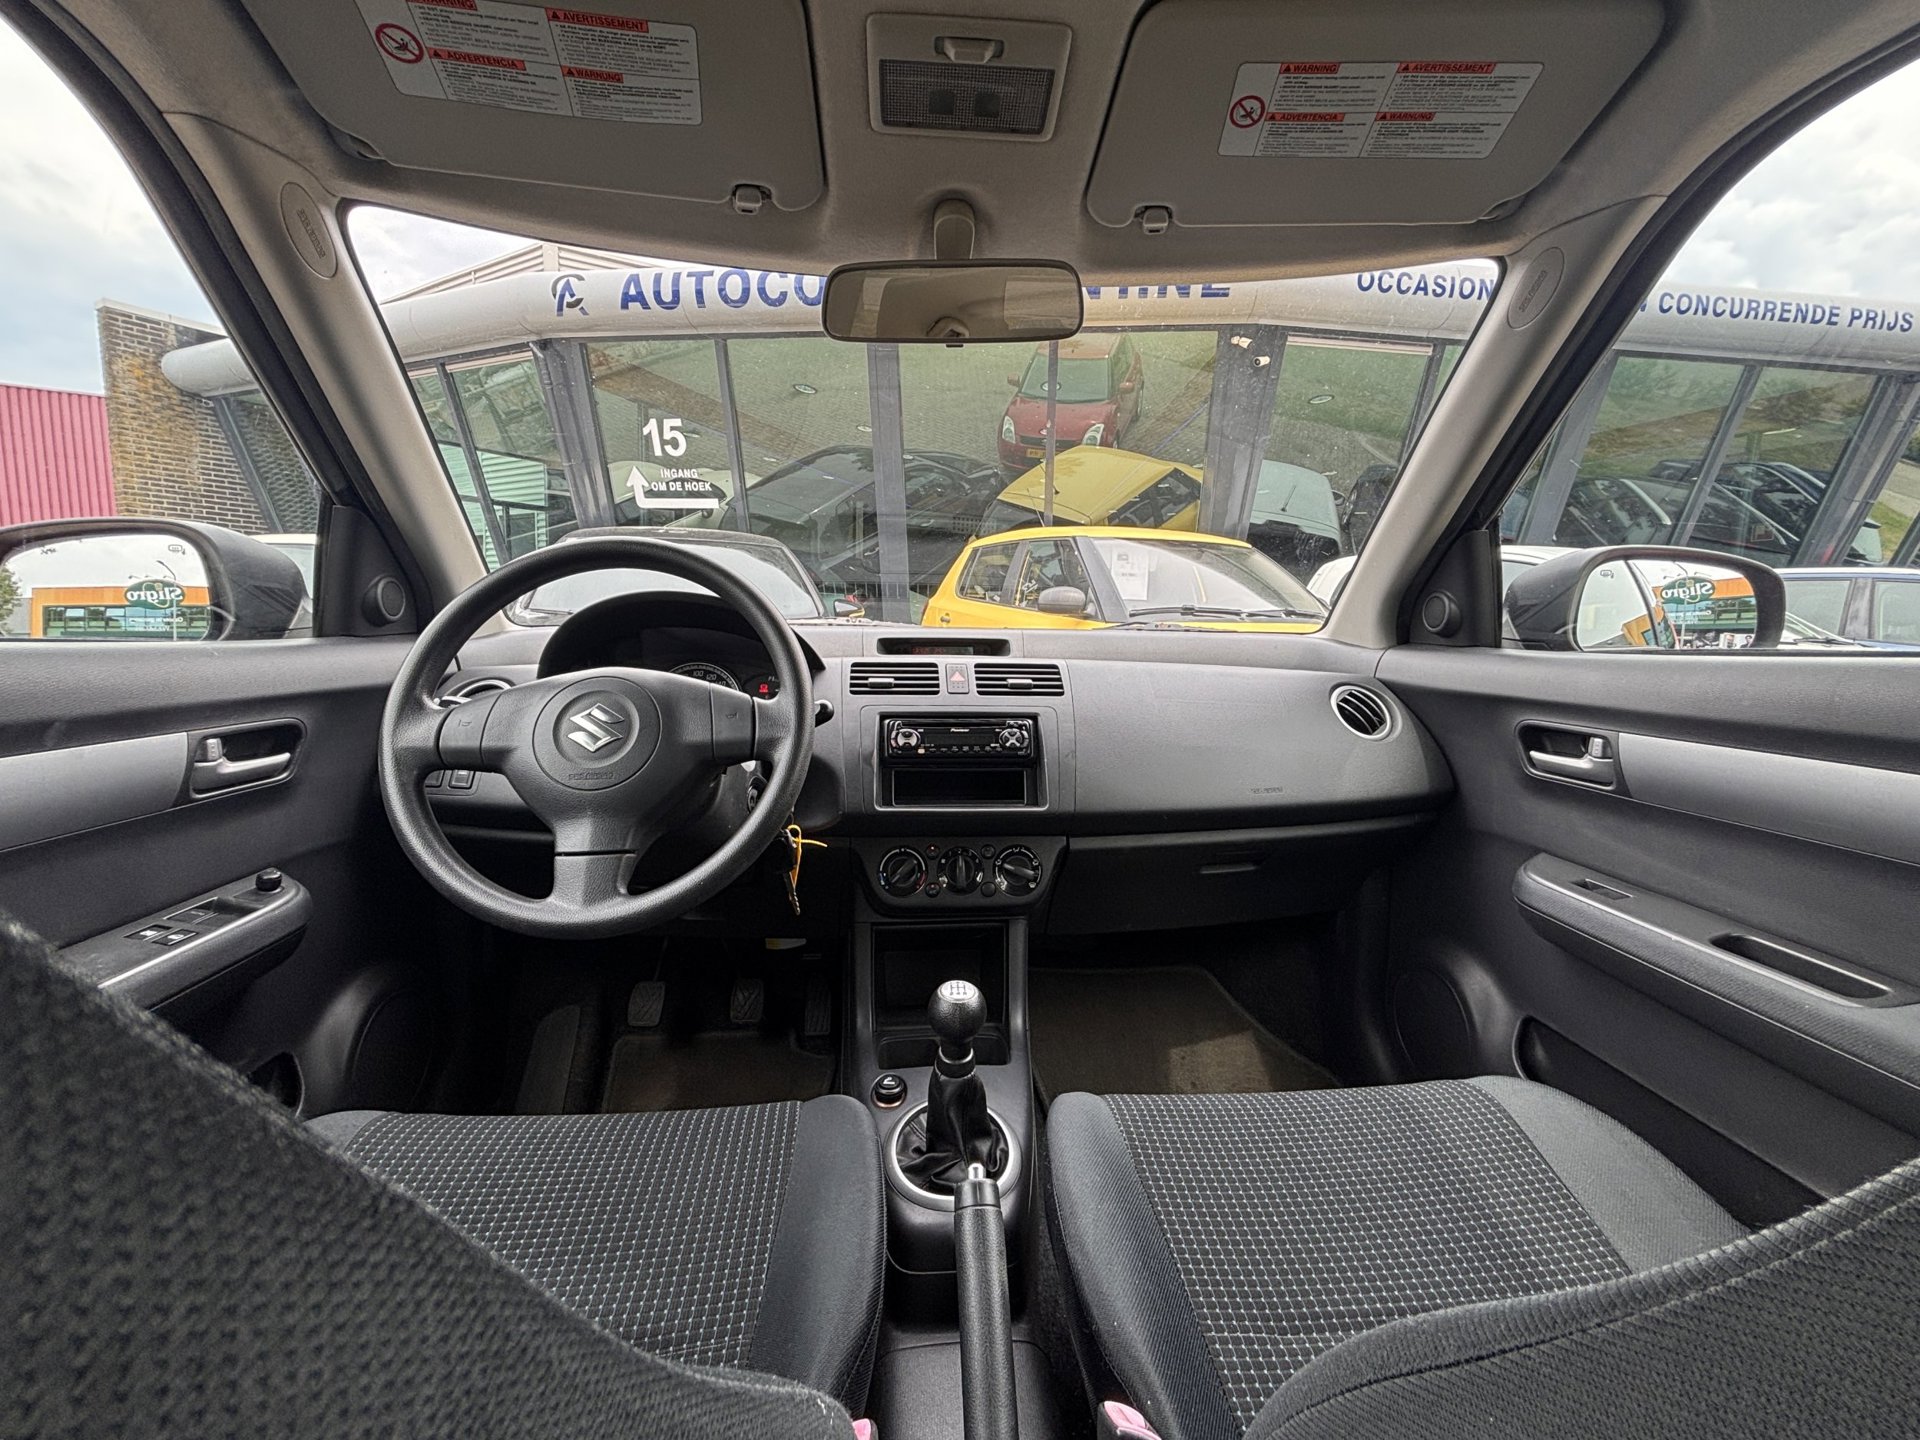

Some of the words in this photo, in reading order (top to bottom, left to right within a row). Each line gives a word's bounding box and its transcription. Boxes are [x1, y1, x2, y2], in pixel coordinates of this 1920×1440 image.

[563, 12, 644, 31] AVERTISSEMENT
[446, 51, 518, 68] ADVERTENCIA
[1293, 64, 1337, 73] WARNING
[1412, 63, 1491, 73] AVERTISSEMENT
[575, 68, 621, 82] WARNUNG
[1280, 113, 1338, 121] ADVERTENCIA
[1389, 112, 1432, 121] WARNUNG
[1658, 292, 1840, 327] CONCURRENDE
[1847, 307, 1914, 333] PRIJS
[642, 418, 687, 457] 15
[660, 468, 698, 478] INGANG
[651, 481, 667, 491] OM
[669, 482, 683, 491] DE
[685, 482, 712, 491] HOEK
